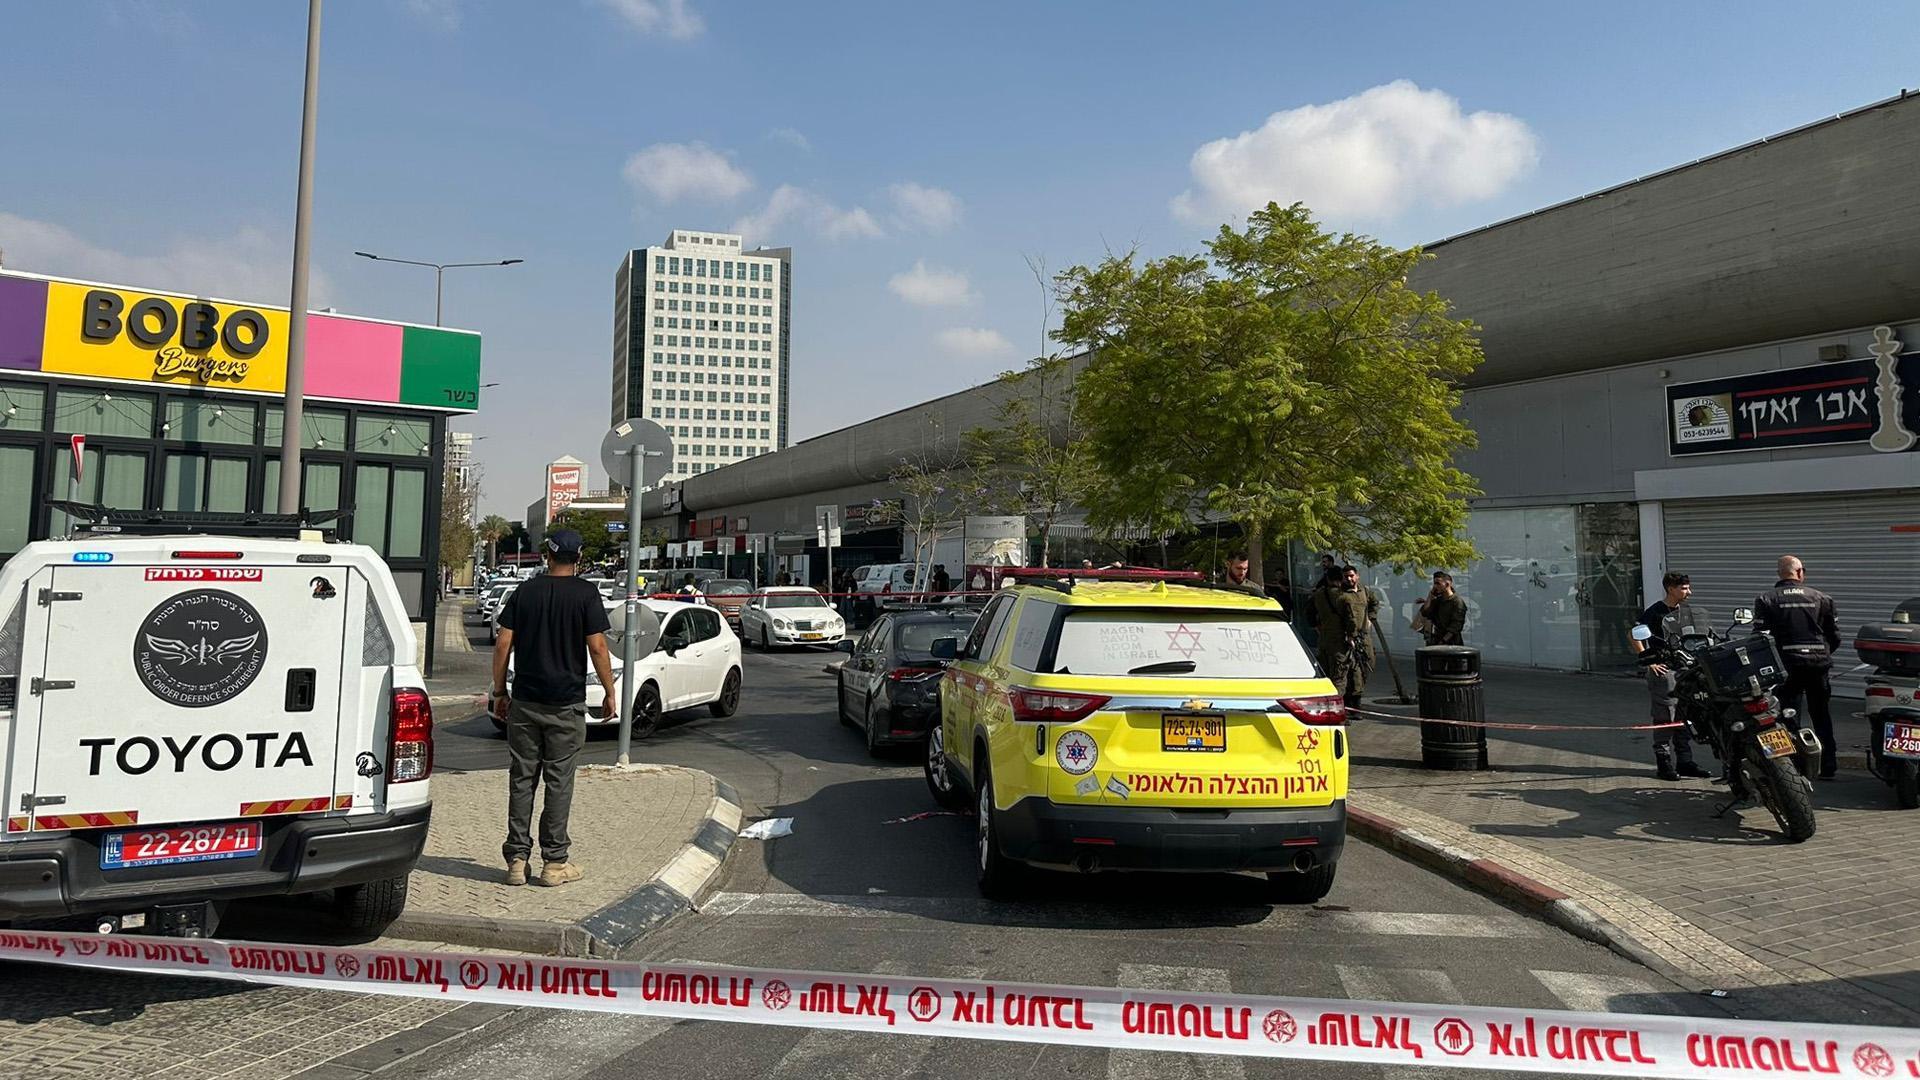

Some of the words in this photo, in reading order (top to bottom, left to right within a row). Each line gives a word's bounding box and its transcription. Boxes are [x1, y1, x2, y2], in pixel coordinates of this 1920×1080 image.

[82, 290, 269, 354] BOBO
[159, 346, 250, 380] Burgers
[443, 389, 476, 403] כשר
[1815, 388, 1868, 421] אבו
[1739, 396, 1801, 439] זאקי
[147, 569, 204, 580] מרחק
[210, 569, 261, 579] שמור
[238, 608, 254, 624] סדר
[1100, 626, 1144, 635] MAGEN
[1101, 634, 1139, 643] DAVID
[1103, 642, 1142, 651] ADOM
[1119, 649, 1161, 660] ISRAEL
[140, 651, 157, 680] PUBLIC
[152, 677, 180, 700] ORDER
[180, 690, 222, 703] DEFENCE
[221, 648, 262, 696] SOVEREIGNTY
[80, 731, 313, 776] TOYOTA
[1297, 758, 1321, 774] 101
[1128, 772, 1203, 794] הלאומי
[1209, 773, 1278, 795] ההצלה
[1284, 774, 1329, 799] ארגון
[229, 945, 326, 975] משטרת
[367, 955, 449, 992] ישראל
[497, 959, 533, 992] אין
[541, 965, 618, 998] מעבר
[641, 970, 754, 1007] משטרת
[799, 982, 895, 1026] ישראל
[952, 986, 994, 1024] אין
[1004, 993, 1093, 1030] מעבר
[1122, 1000, 1252, 1040] משטרת
[1307, 1013, 1423, 1059] ישראל
[1485, 1017, 1538, 1057] אין
[1546, 1025, 1656, 1064] מעבר
[1685, 1032, 1841, 1074] משטרת
